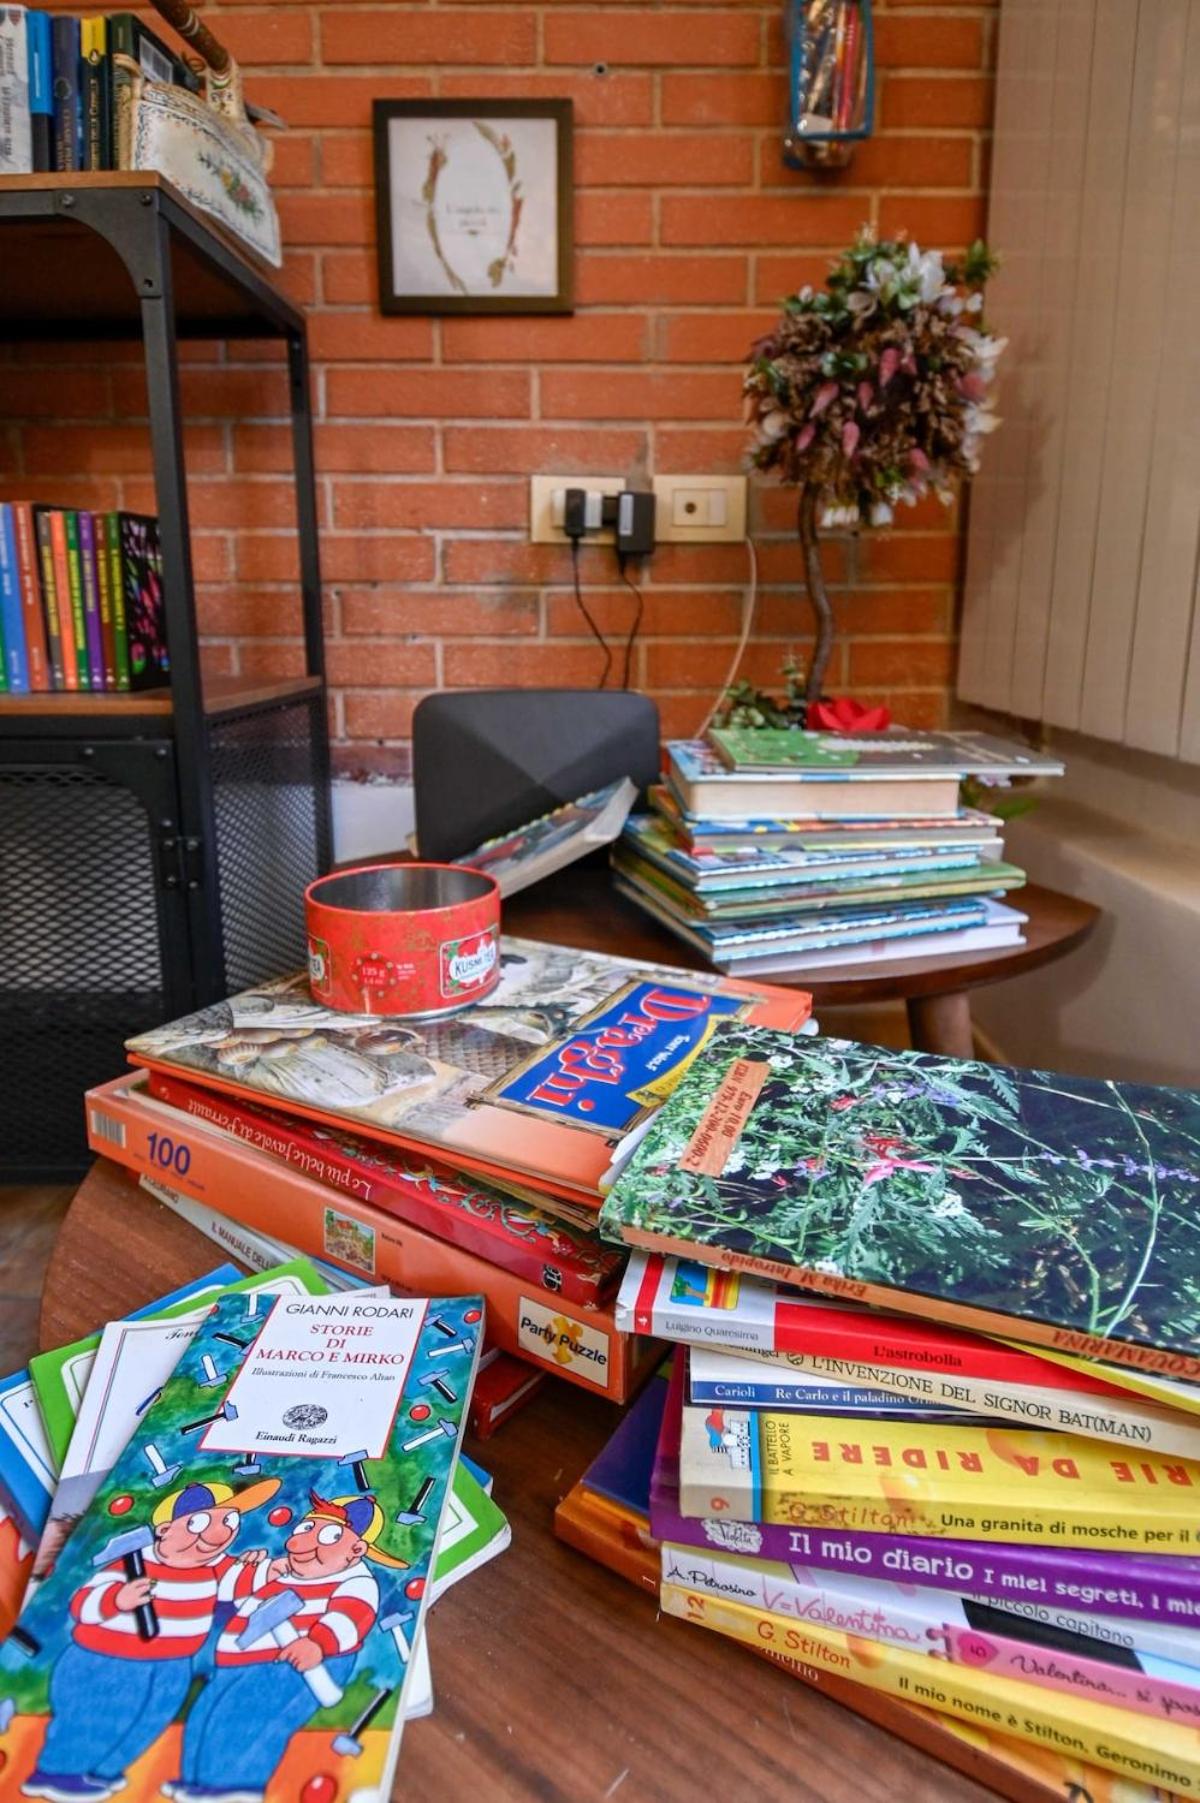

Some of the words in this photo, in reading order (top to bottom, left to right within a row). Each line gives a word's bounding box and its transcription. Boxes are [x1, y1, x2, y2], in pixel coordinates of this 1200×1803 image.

[526, 988, 711, 1112] Draghi
[732, 1063, 749, 1085] ISBN
[739, 1091, 753, 1111] Euro
[188, 1099, 242, 1135] Perrault
[147, 1132, 191, 1176] 100
[252, 1129, 298, 1161] favole
[295, 1150, 327, 1179] belle
[350, 1177, 373, 1200] Le
[824, 1274, 868, 1297] Erika
[286, 1302, 349, 1317] GIANNI
[351, 1306, 414, 1319] RODARI
[311, 1323, 374, 1337] STORIE
[665, 1319, 702, 1336] Luigino
[326, 1338, 345, 1349] DI
[521, 1316, 556, 1345] Party
[559, 1331, 607, 1366] Puzzle
[256, 1349, 323, 1362] MARCO
[328, 1351, 338, 1363] E
[343, 1352, 404, 1366] MIRKO
[874, 1346, 962, 1367] L'astrobolla
[252, 1367, 307, 1379] Illustrazioni
[309, 1369, 319, 1379] di
[321, 1370, 368, 1381] Francesco
[715, 1383, 756, 1398] Carioli
[775, 1388, 792, 1400] Re
[795, 1389, 829, 1401] Carlo
[831, 1392, 839, 1401] e
[842, 1389, 851, 1402] il
[854, 1390, 905, 1406] paladino
[812, 1353, 933, 1394] L'INVENZIONE
[941, 1383, 976, 1403] DEL
[984, 1393, 1051, 1420] SIGNOR
[1059, 1411, 1152, 1443] BAT(MAN)
[256, 1431, 296, 1443] Einaudi
[298, 1433, 337, 1445] Ragazzi
[766, 1420, 779, 1466] BATTELLO
[779, 1422, 792, 1462] VAPORE
[811, 1440, 984, 1474] RIDERE
[1013, 1454, 1081, 1480] DA
[783, 1468, 793, 1476] A
[819, 1503, 908, 1528] Stilton
[941, 1513, 976, 1529] Una
[981, 1517, 1044, 1534] granita
[1049, 1521, 1066, 1535] di
[1072, 1524, 1138, 1540] mosche
[1145, 1529, 1175, 1544] per
[1180, 1529, 1189, 1543] il
[789, 1532, 811, 1555] Il
[822, 1538, 872, 1564] mio
[882, 1548, 974, 1581] diario
[984, 1569, 995, 1584] I
[1002, 1574, 1047, 1593] miei
[689, 1570, 757, 1598] Petrosino
[687, 1595, 705, 1621] 12
[1056, 1614, 1135, 1647] capitano
[757, 1620, 777, 1643] G.
[784, 1629, 850, 1670] Stilton
[899, 1676, 909, 1690] Il
[915, 1685, 946, 1703] mio
[952, 1695, 1001, 1721] nome
[1008, 1713, 1018, 1728] è
[1096, 1743, 1192, 1787] Geronimo
